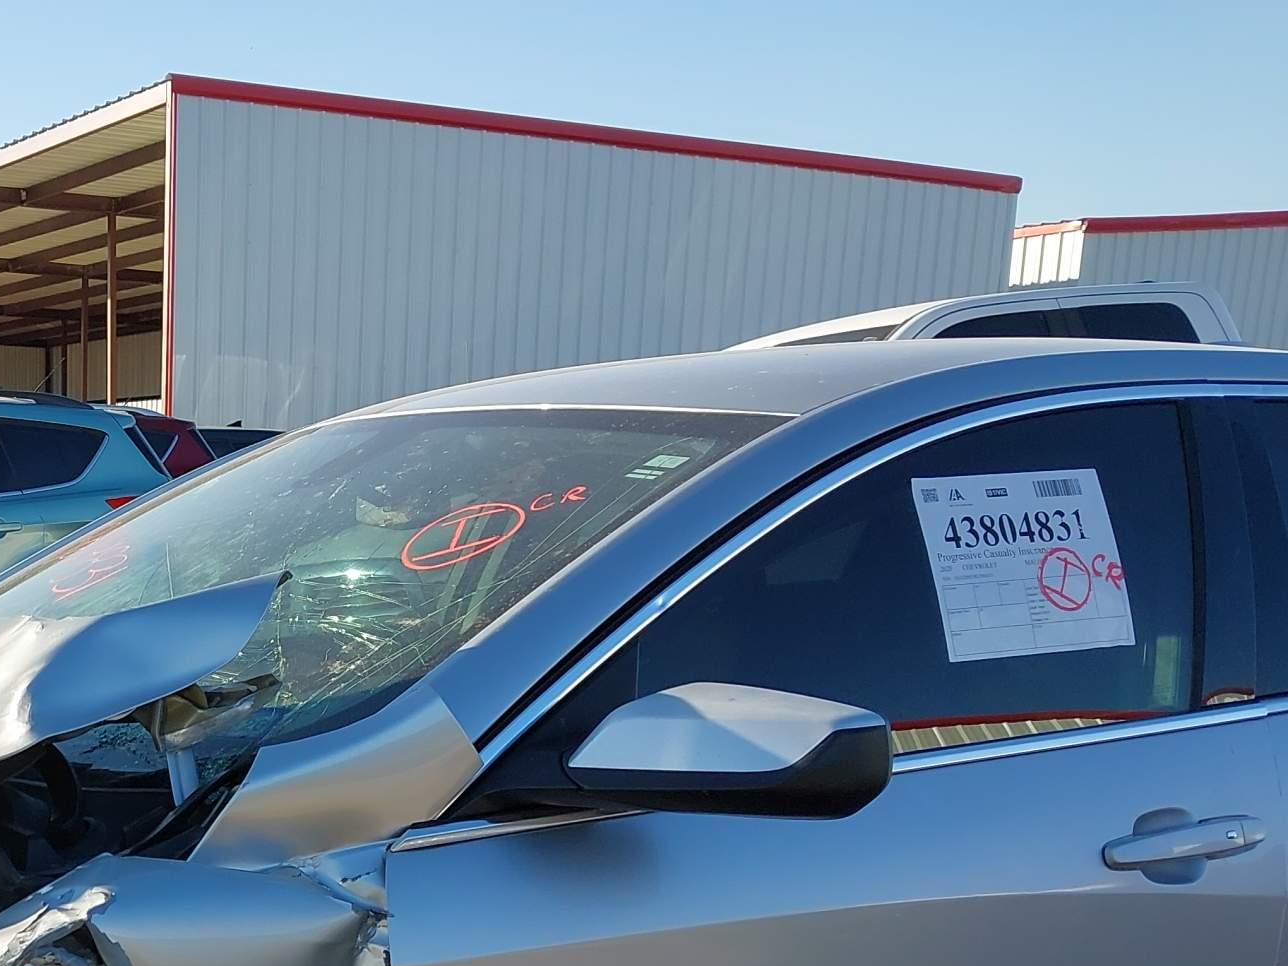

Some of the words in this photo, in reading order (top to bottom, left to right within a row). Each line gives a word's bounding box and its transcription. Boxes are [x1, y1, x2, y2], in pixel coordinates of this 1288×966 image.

[944, 508, 1091, 549] 43804831
[937, 549, 982, 563] Progressive
[983, 546, 1017, 559] Casualty
